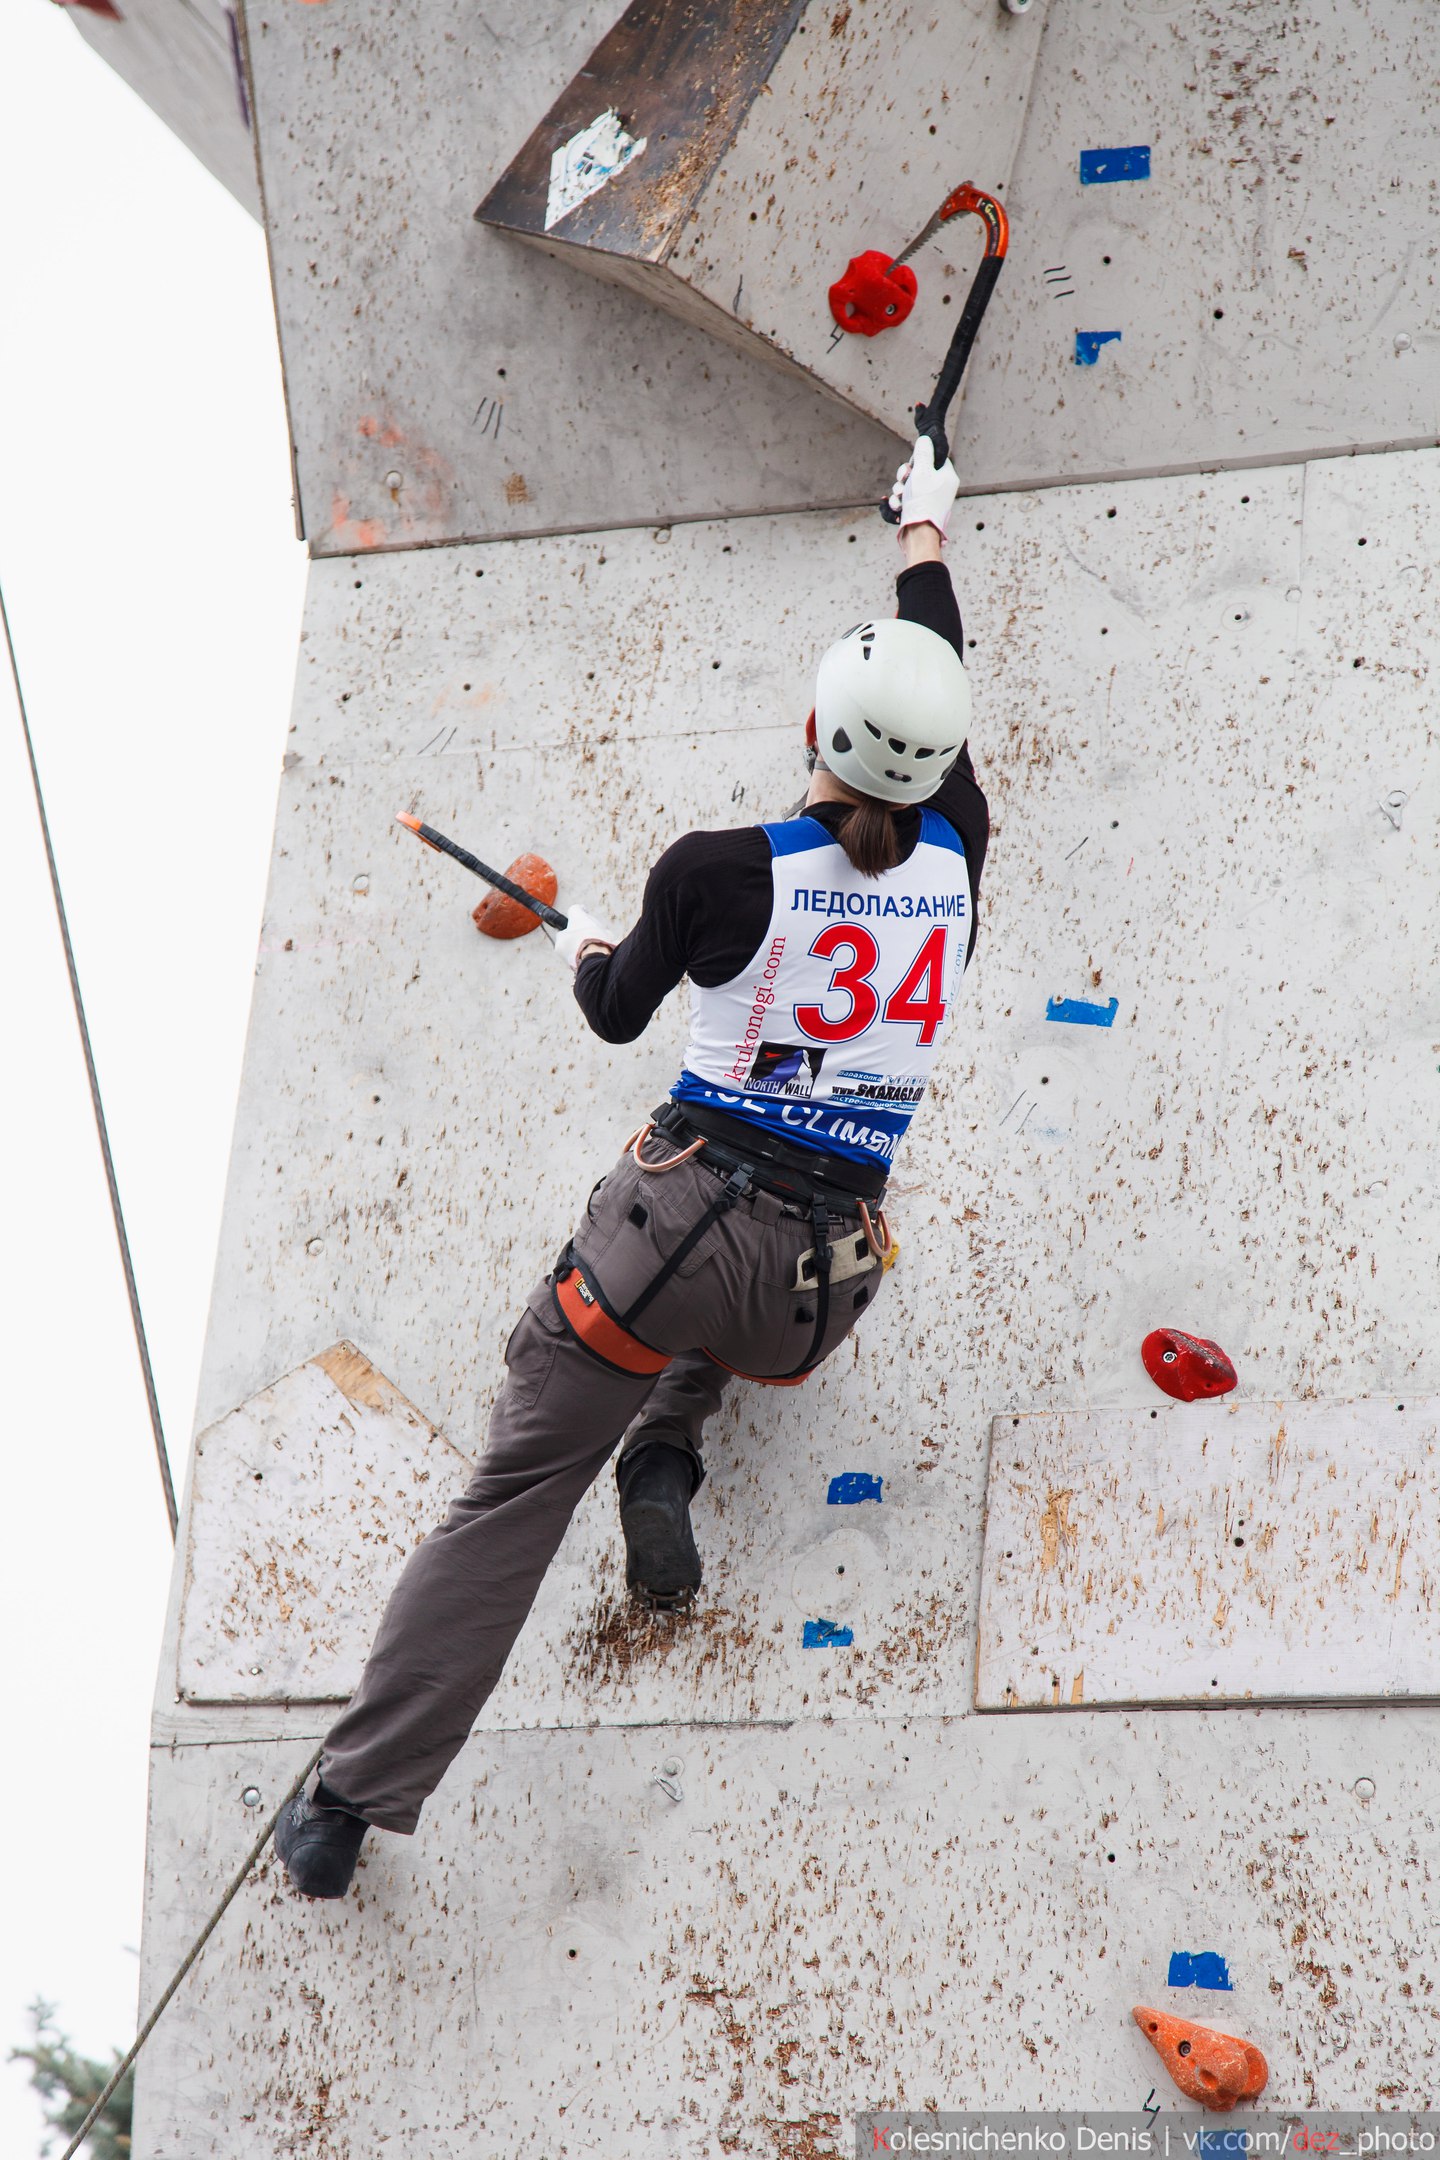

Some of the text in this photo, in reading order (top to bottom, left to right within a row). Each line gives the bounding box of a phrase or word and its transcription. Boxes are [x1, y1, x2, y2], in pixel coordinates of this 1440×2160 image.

[791, 889, 965, 918] ЛЕДОЛАЗАНИЕ
[724, 936, 786, 1082] krukonogi.com
[793, 921, 948, 1046] 34
[746, 1077, 811, 1097] NORTH WALL
[782, 1105, 904, 1159] CLIMBIN
